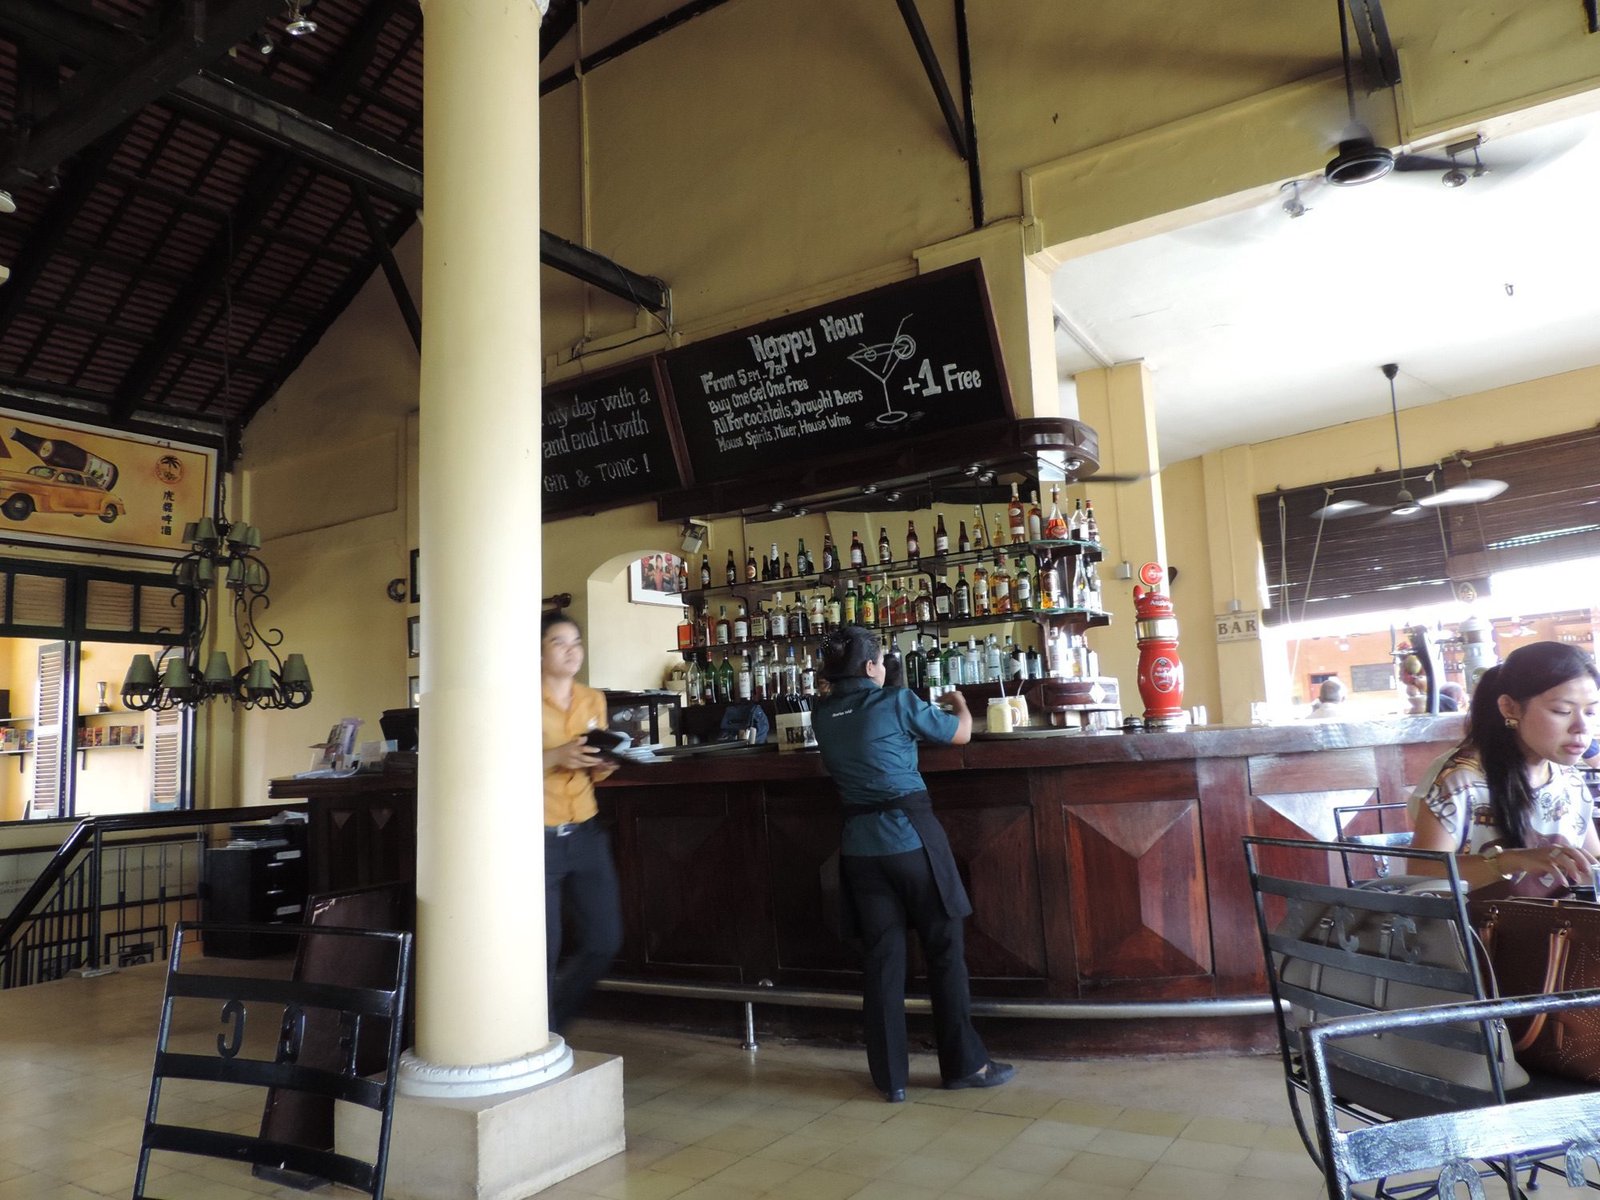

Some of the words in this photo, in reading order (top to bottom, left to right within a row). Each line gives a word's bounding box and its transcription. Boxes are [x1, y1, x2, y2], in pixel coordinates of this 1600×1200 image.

[748, 327, 816, 367] Happy
[819, 312, 864, 343] Hour
[700, 371, 737, 394] From
[707, 397, 733, 417] Buy
[732, 392, 750, 407] One
[749, 381, 767, 403] Get
[765, 380, 786, 398] One
[785, 375, 809, 393] Free
[942, 363, 982, 391] Free
[547, 406, 569, 428] my
[572, 393, 598, 421] day
[600, 386, 636, 412] with
[639, 387, 651, 404] a
[712, 416, 729, 435] All
[725, 412, 744, 431] For
[791, 390, 834, 418] Draught
[835, 389, 864, 406] Beers
[542, 428, 571, 458] and
[570, 422, 600, 450] end
[612, 409, 649, 440] with
[715, 435, 744, 453] House
[799, 419, 827, 437] House
[825, 412, 851, 429] Wine
[543, 473, 569, 492] Gin
[575, 469, 591, 487] &
[1217, 619, 1257, 636] BAR
